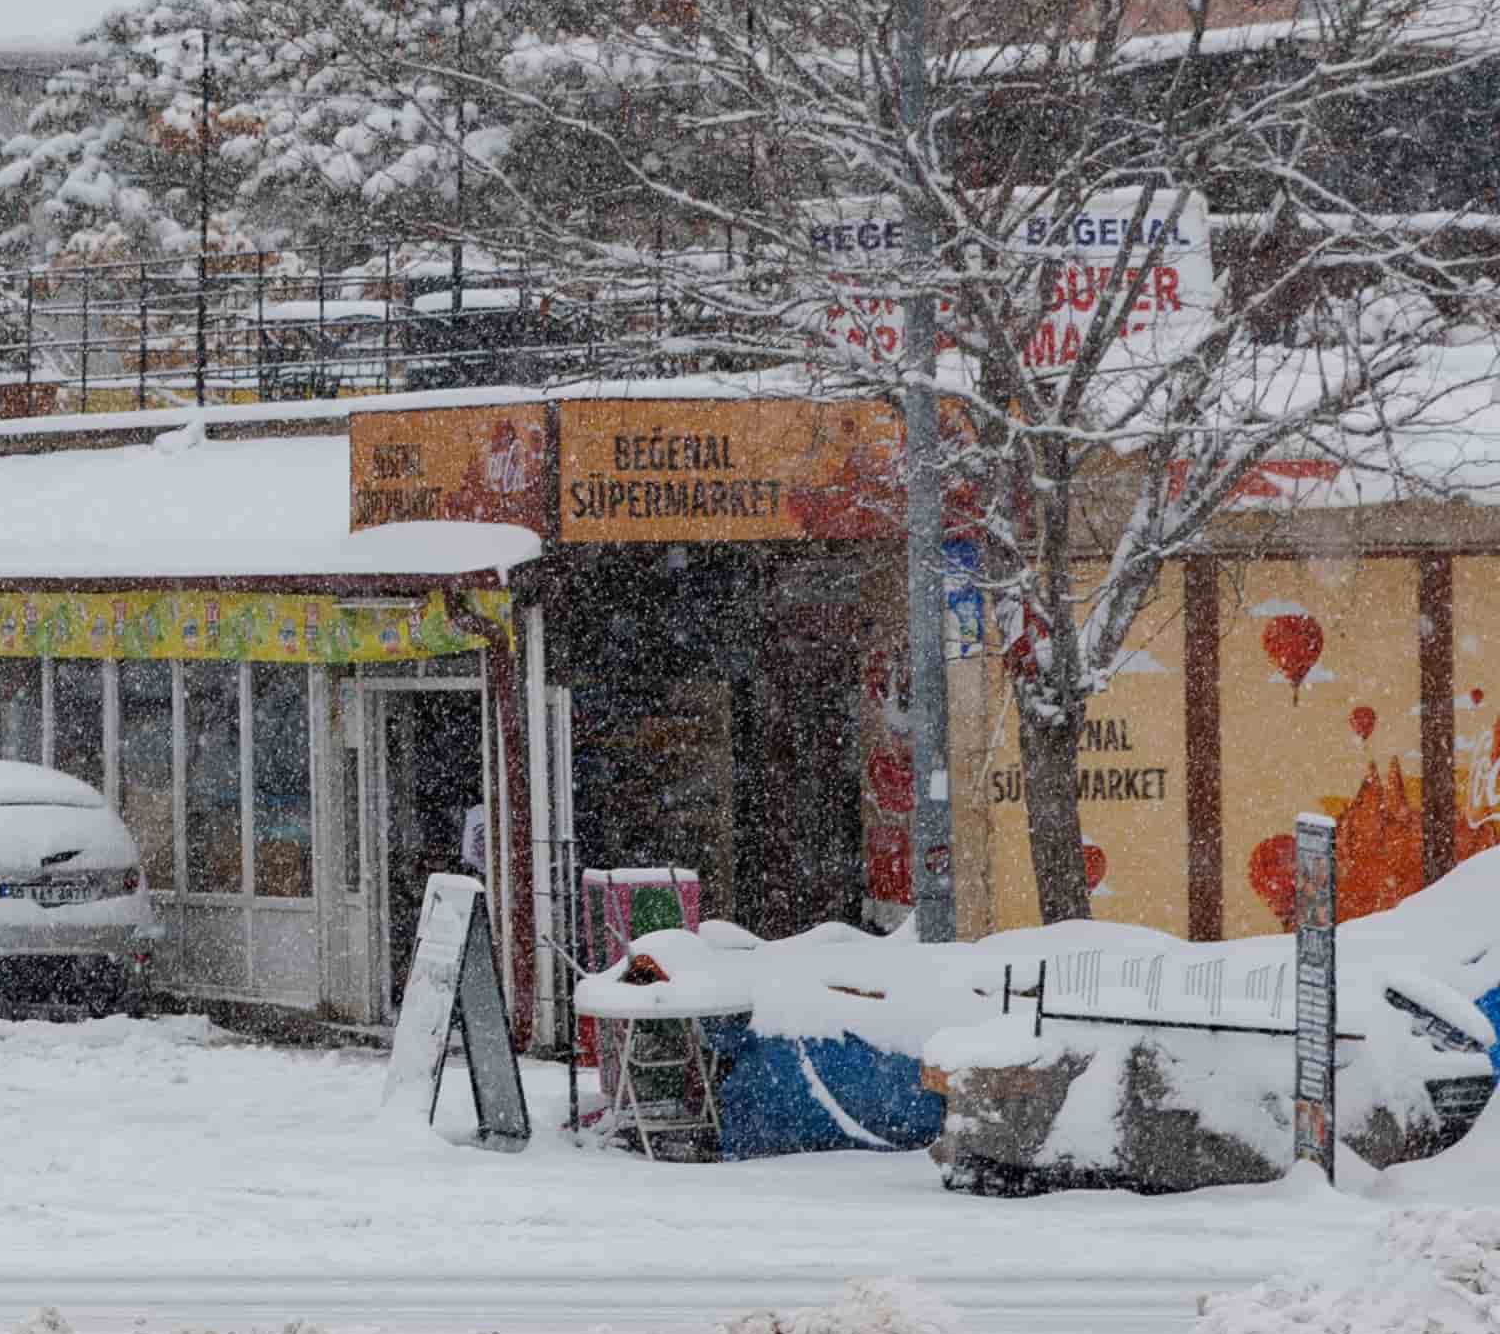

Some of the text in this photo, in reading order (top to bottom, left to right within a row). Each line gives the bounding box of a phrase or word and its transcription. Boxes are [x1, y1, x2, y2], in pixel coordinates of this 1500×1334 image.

[1026, 212, 1191, 246] BĞEAL
[614, 426, 736, 471] BEĞENAL
[570, 473, 781, 518] SÜPERMARKET
[992, 763, 1167, 804] SÜMARKET
